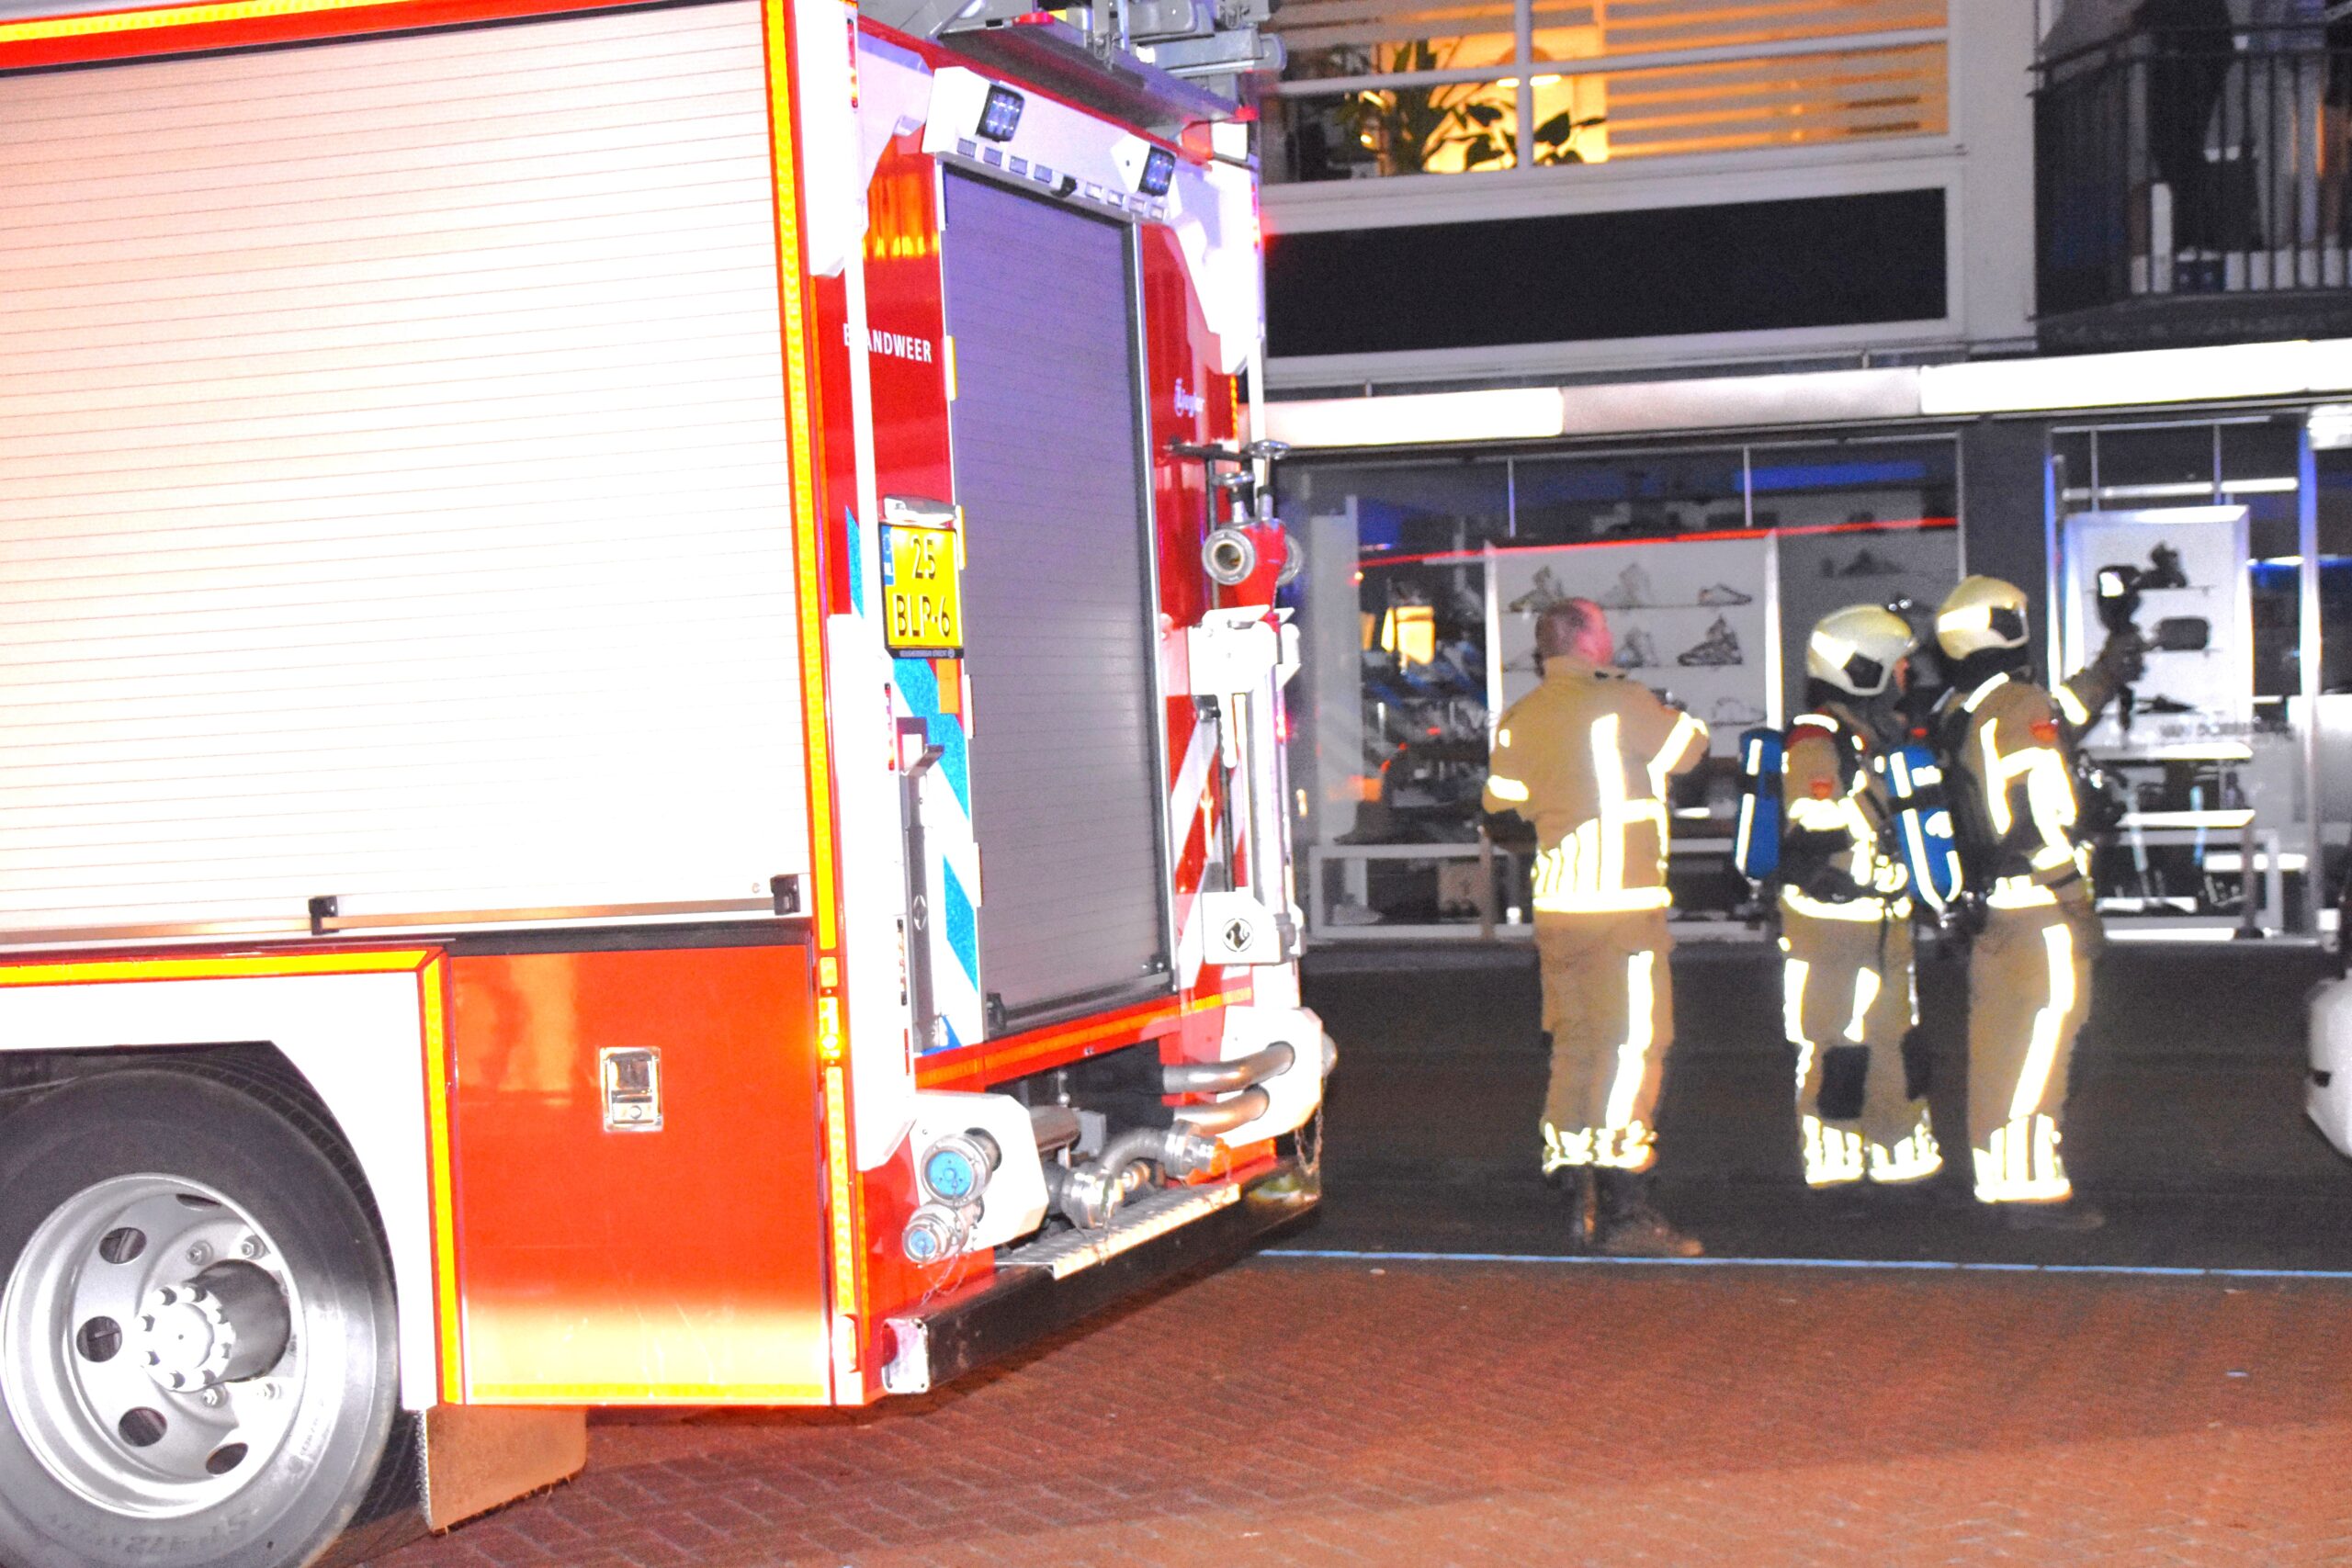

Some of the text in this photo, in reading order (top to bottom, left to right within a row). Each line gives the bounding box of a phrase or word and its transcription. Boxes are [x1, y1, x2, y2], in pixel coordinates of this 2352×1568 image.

[842, 322, 933, 364] BANDWEER
[910, 536, 937, 581] 25
[893, 593, 952, 638] BLP-6
